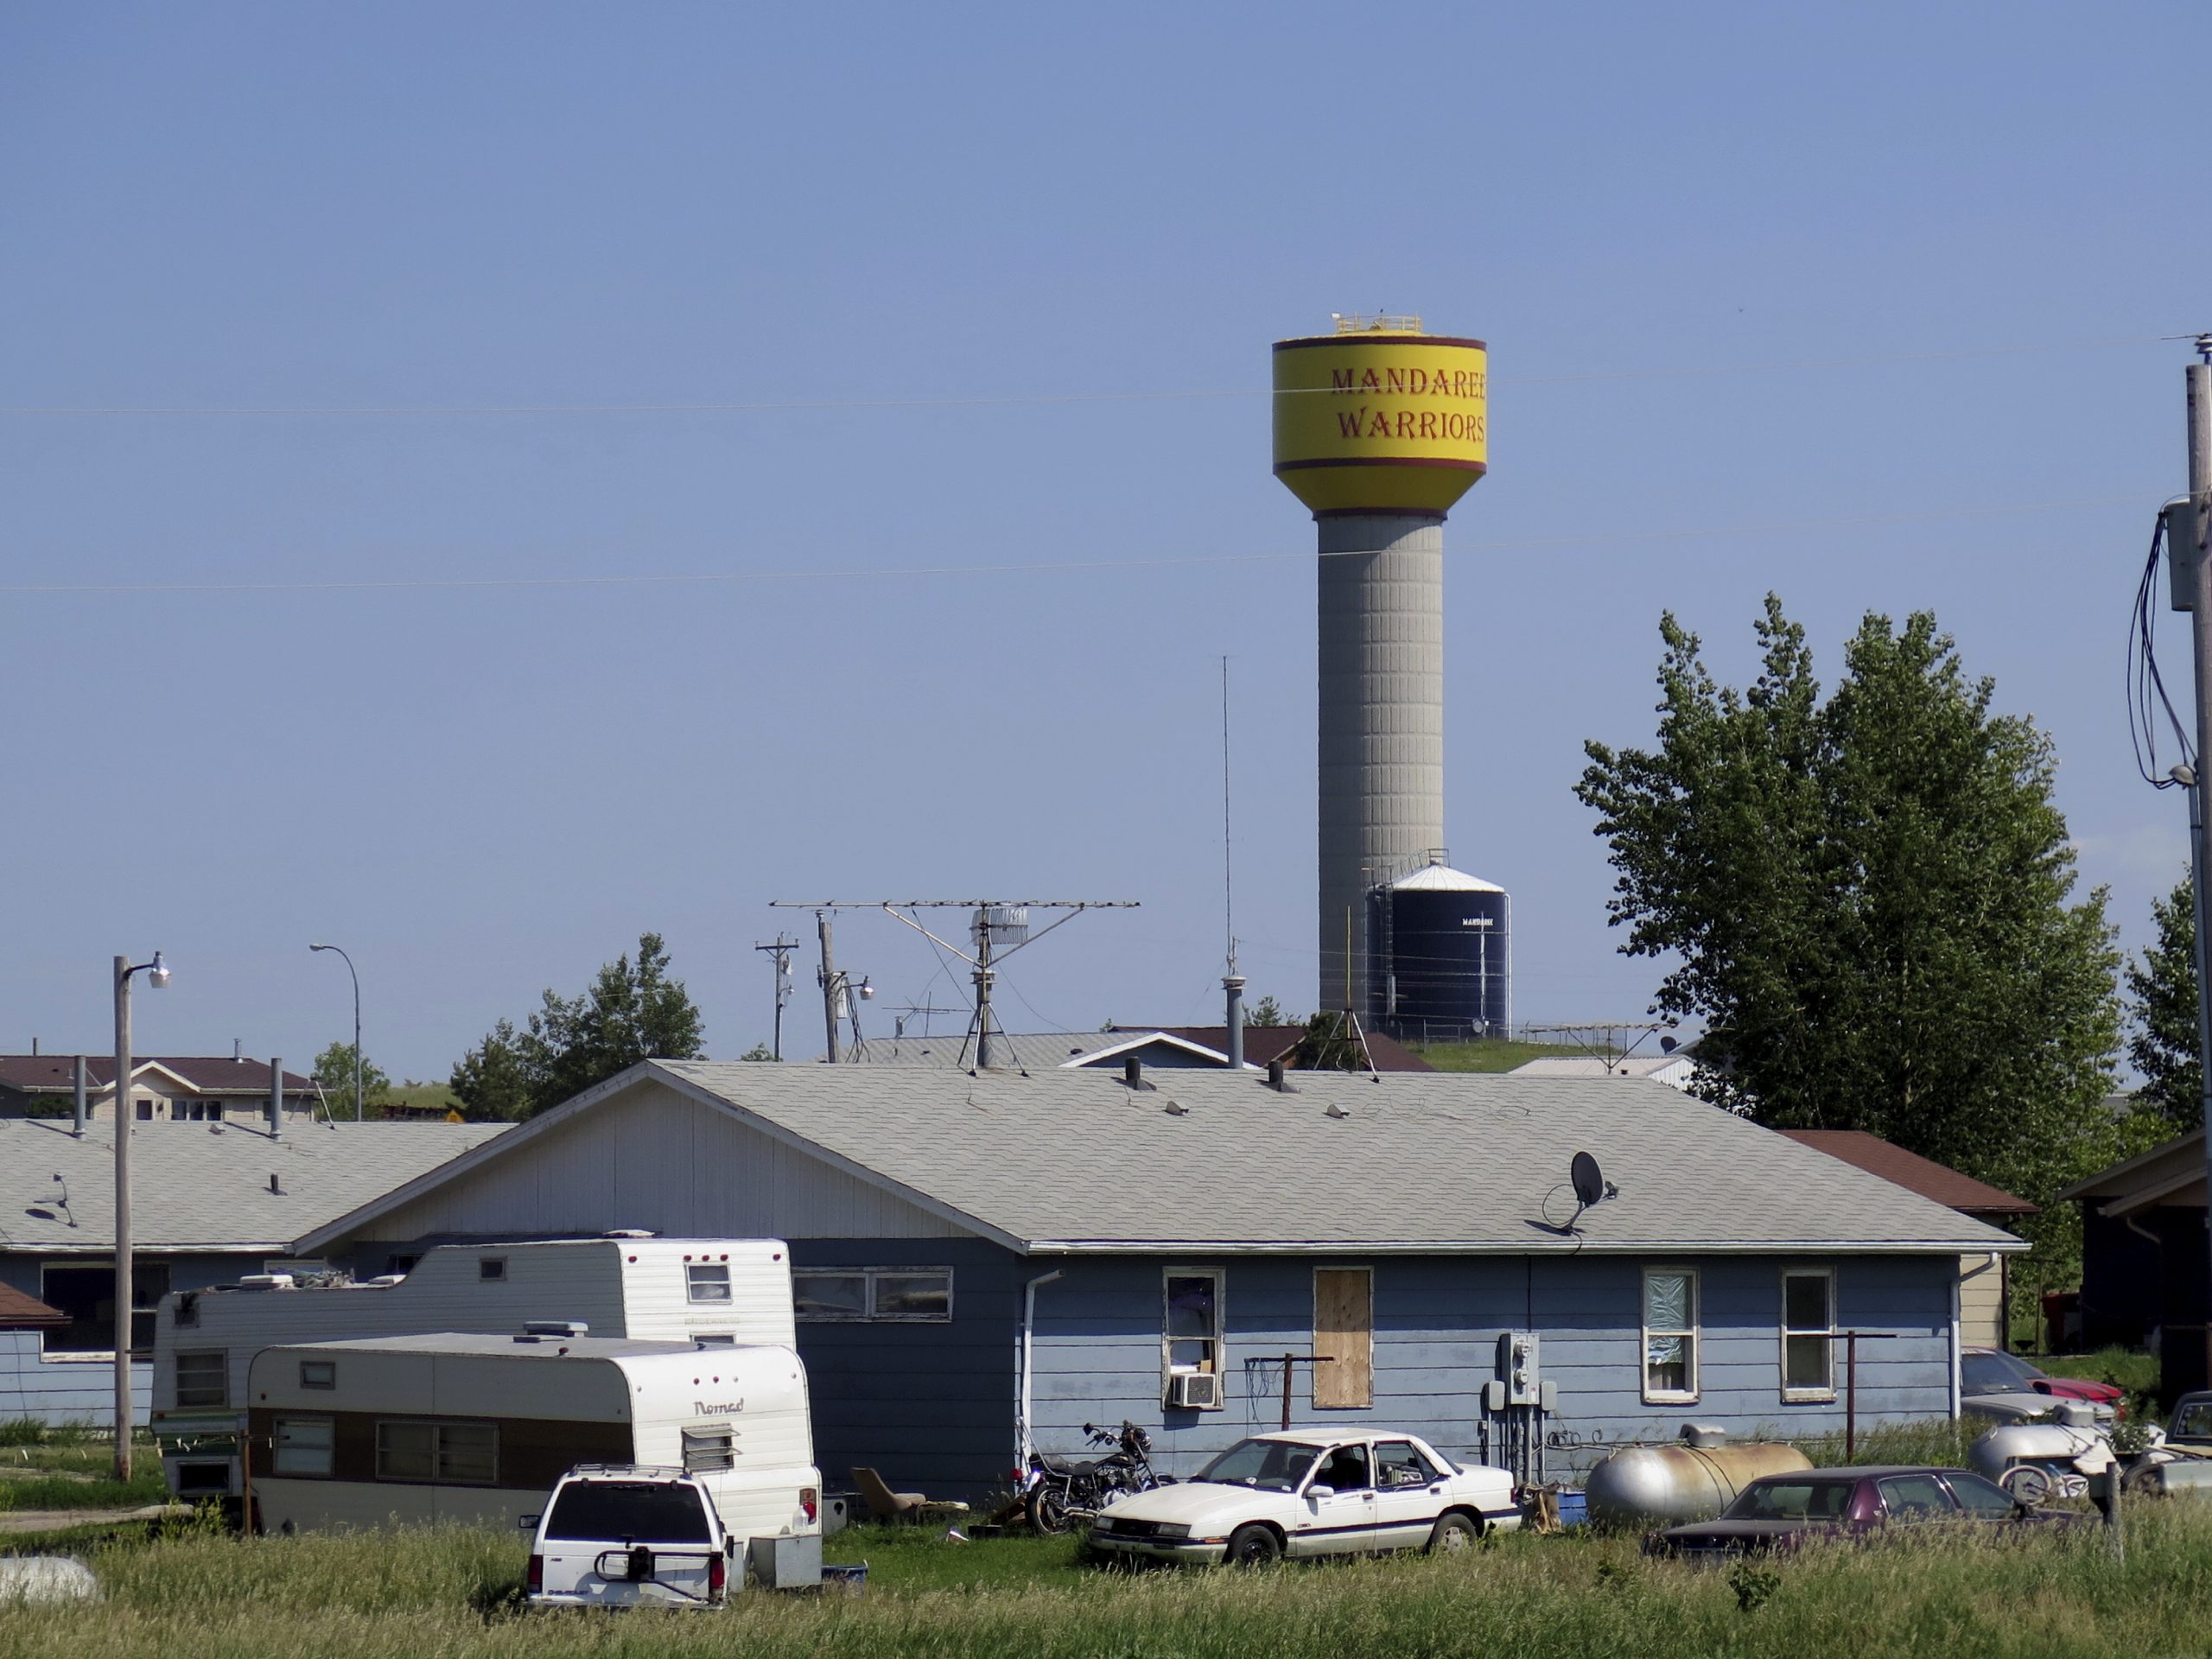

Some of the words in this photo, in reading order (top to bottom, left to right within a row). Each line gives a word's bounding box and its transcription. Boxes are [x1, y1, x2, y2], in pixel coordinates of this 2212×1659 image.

[1331, 367, 1485, 400] MANDAREE
[1337, 406, 1484, 442] WARRIORS
[693, 1397, 744, 1415] Nomad
